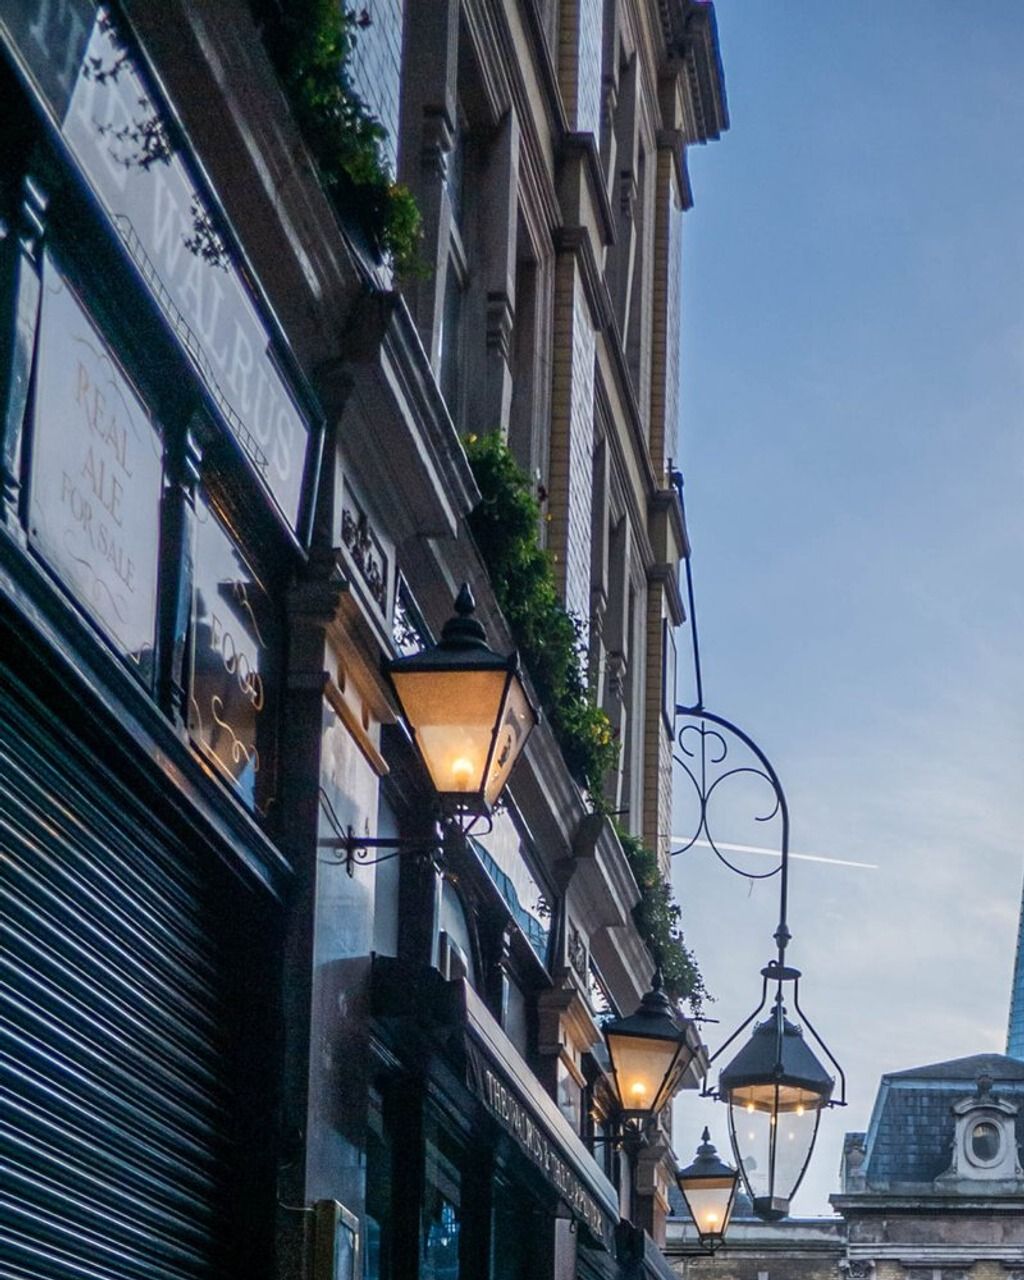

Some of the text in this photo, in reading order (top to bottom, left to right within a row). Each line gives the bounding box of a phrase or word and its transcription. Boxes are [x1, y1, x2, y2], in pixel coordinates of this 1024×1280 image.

[153, 176, 296, 482] WALRUS
[75, 357, 133, 478] REAL
[60, 470, 136, 593] FOR SALE
[80, 446, 124, 528] ALE
